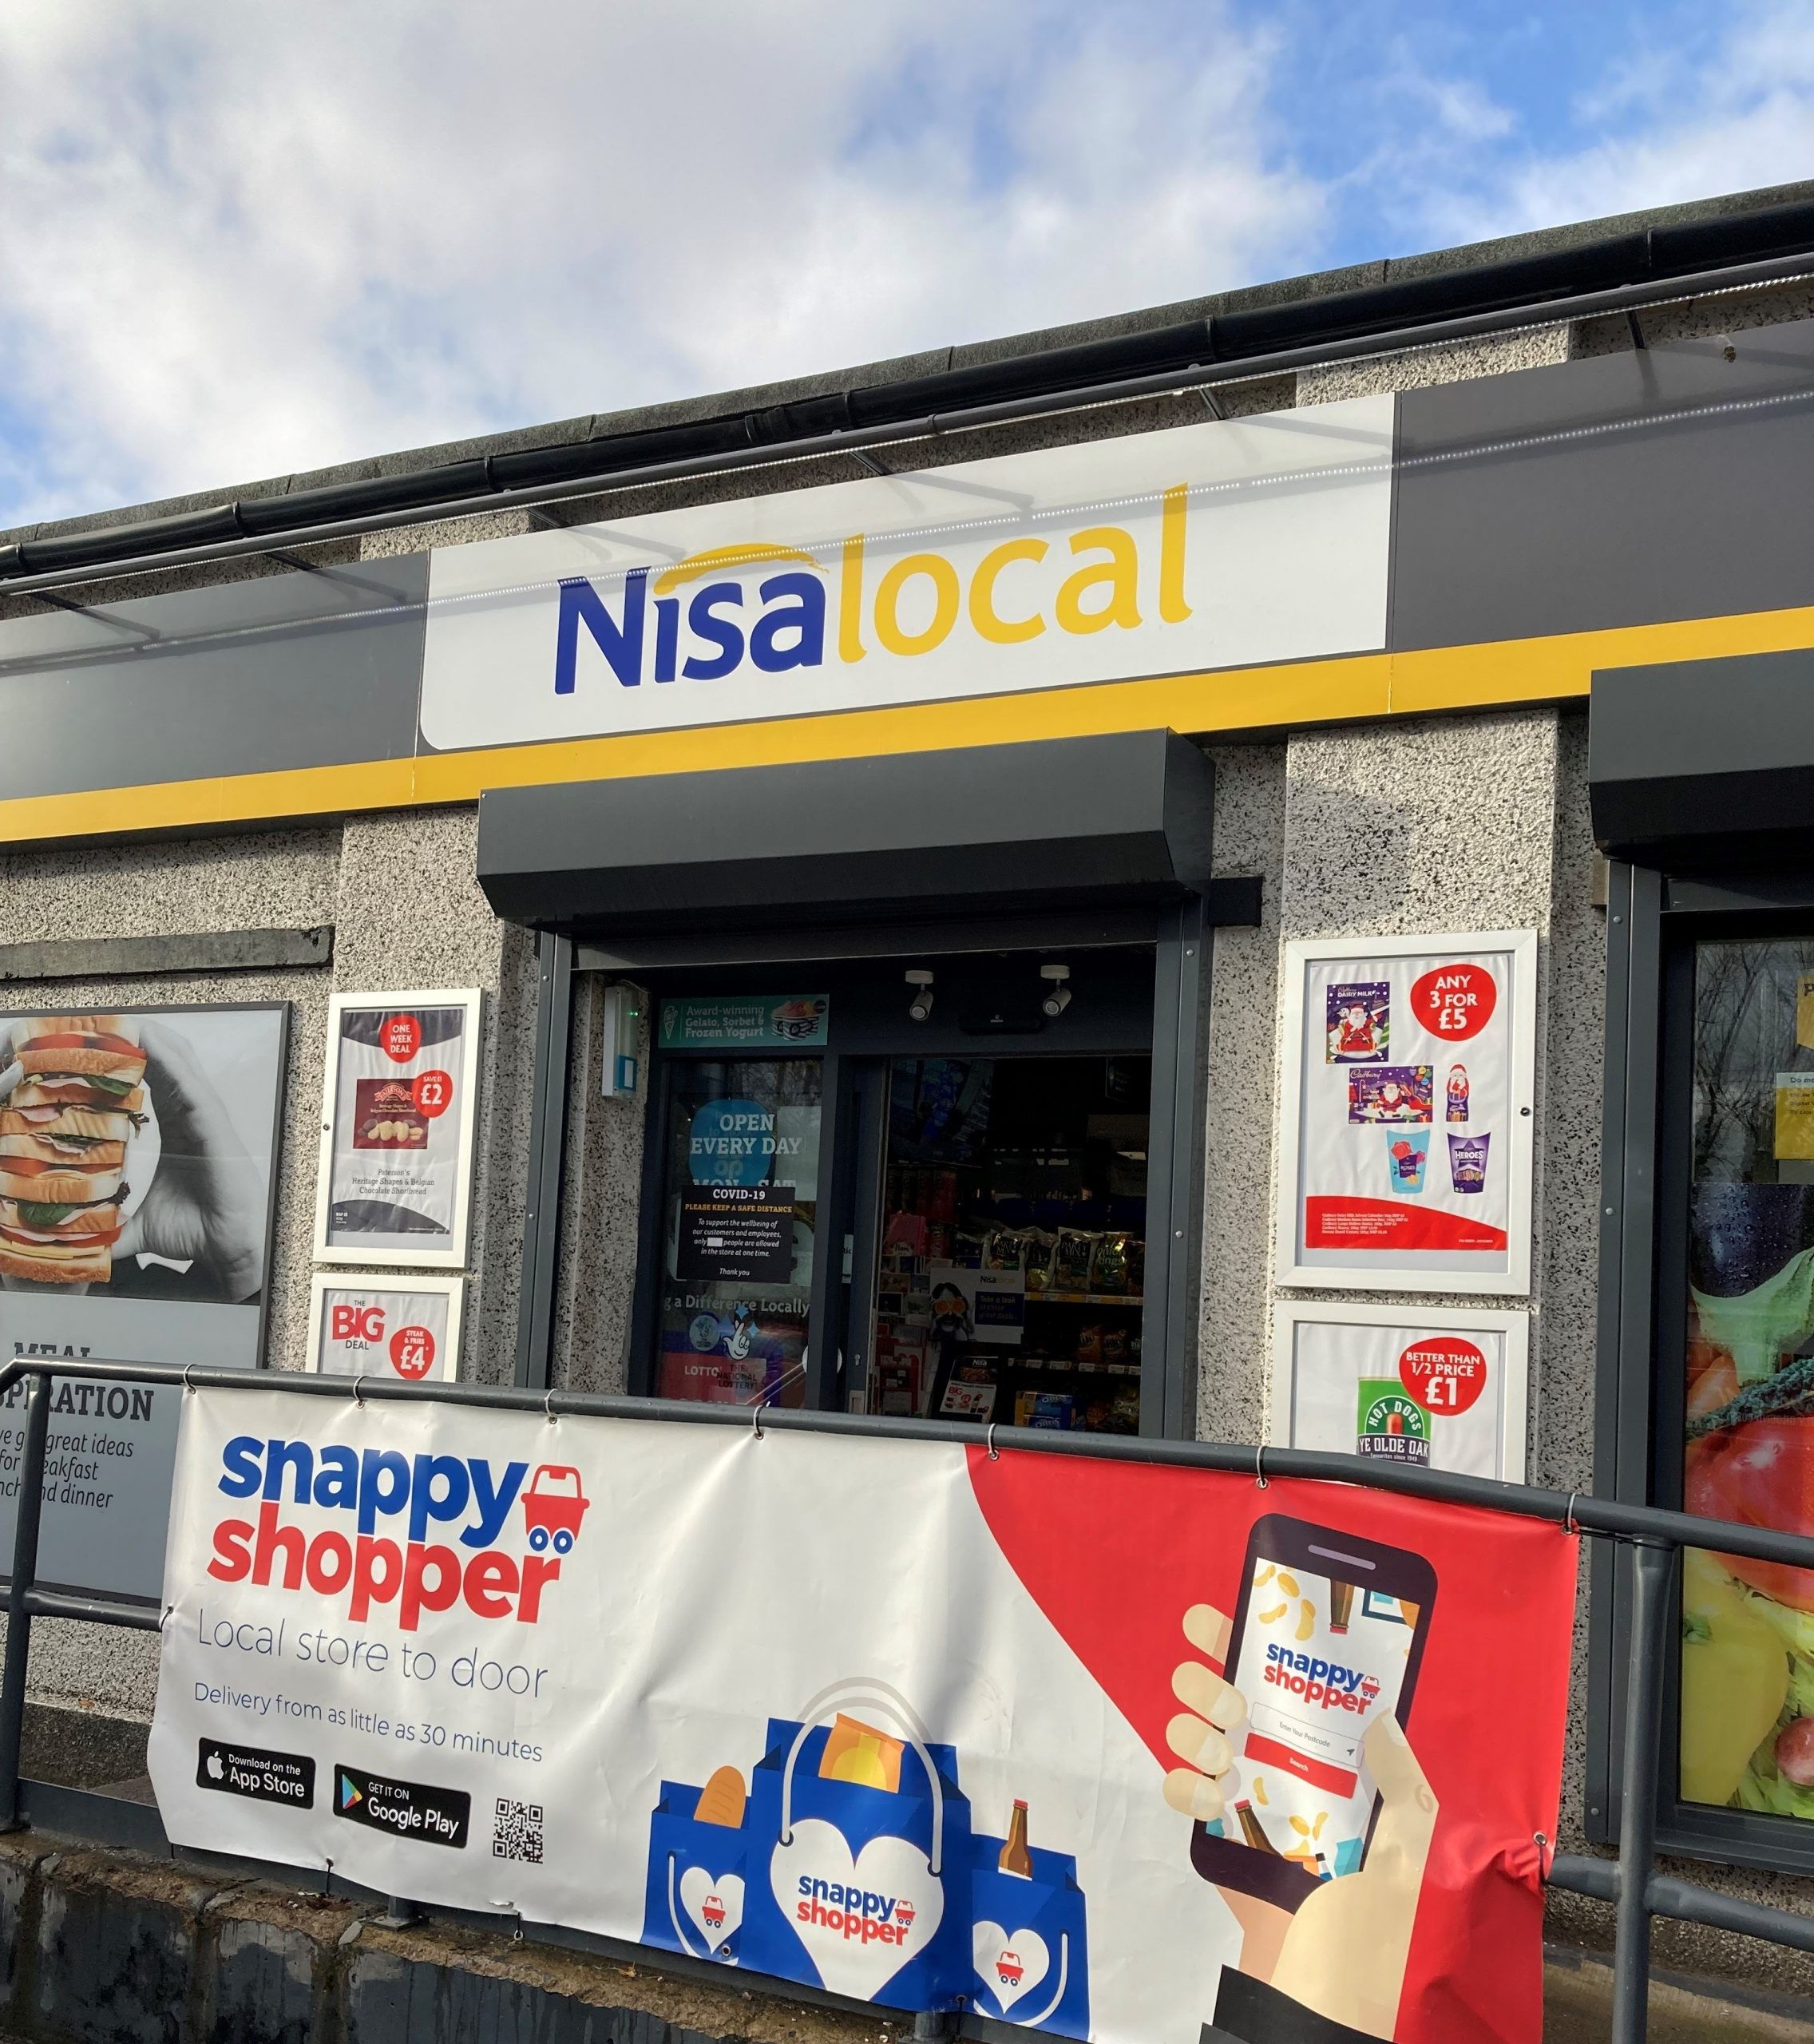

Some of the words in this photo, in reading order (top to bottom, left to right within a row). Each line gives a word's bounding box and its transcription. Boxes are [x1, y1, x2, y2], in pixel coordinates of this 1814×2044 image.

[1435, 974, 1472, 990] ANY
[1429, 991, 1441, 1008] 3
[1445, 991, 1479, 1008] FOR
[686, 1005, 765, 1016] Award-winning
[1438, 1007, 1467, 1030] £5
[392, 1024, 411, 1034] ONE
[685, 1017, 720, 1028] Gelato,
[723, 1016, 755, 1026] Sorbet
[390, 1034, 412, 1044] WEEK
[685, 1027, 723, 1038] Frozen
[726, 1027, 764, 1039] Yogurt
[390, 1044, 411, 1053] DEAL
[1349, 1068, 1381, 1079] Cadbury
[421, 1083, 443, 1105] £2
[719, 1114, 775, 1131] OPEN
[690, 1137, 758, 1155] EVERY
[762, 1137, 802, 1155] DAY
[1455, 1151, 1483, 1161] HEROES
[379, 1178, 403, 1186] Shapes
[410, 1178, 435, 1186] Belgian
[713, 1189, 766, 1200] COVID-19
[706, 1218, 729, 1227] support
[723, 1239, 744, 1248] people
[980, 1275, 996, 1284] Nisa
[674, 1299, 682, 1308] a
[685, 1294, 757, 1310] Difference
[760, 1298, 810, 1317] Locally
[332, 1305, 386, 1343] BIG
[345, 1339, 370, 1350] DEAL
[1405, 1352, 1445, 1363] BETTER
[1448, 1353, 1481, 1365] THAN
[684, 1365, 719, 1377] LOTTO
[716, 1372, 757, 1382] NATIONAL
[1411, 1362, 1432, 1377] 1/2
[1435, 1363, 1475, 1377] PRICE
[1424, 1376, 1457, 1406] £1
[1368, 1402, 1388, 1427] HOT
[1394, 1400, 1421, 1431] DOGS
[46, 1434, 88, 1454] great
[91, 1433, 134, 1457] ideas
[1359, 1437, 1371, 1452] YE
[1373, 1437, 1405, 1453] OLDE
[1408, 1440, 1429, 1458] OAK
[0, 1449, 21, 1471] for
[43, 1456, 99, 1482] eakfast
[42, 1481, 57, 1502] nd
[61, 1483, 113, 1507] dinner
[217, 1435, 530, 1549] snappy
[206, 1500, 561, 1632] shopper
[198, 1608, 285, 1657] Local
[296, 1628, 389, 1673] store
[401, 1644, 437, 1681] to
[451, 1647, 549, 1698] door
[1265, 1642, 1364, 1693] snappy
[1263, 1663, 1372, 1715] shopper
[194, 1682, 271, 1715] Delivery
[275, 1695, 322, 1721] from
[328, 1707, 347, 1725] as
[351, 1709, 389, 1736] little
[394, 1721, 415, 1741] as
[420, 1724, 446, 1747] 30
[454, 1732, 543, 1763] minutes
[1279, 1721, 1292, 1733] Enter
[1292, 1726, 1304, 1737] Your
[1304, 1733, 1331, 1748] Postcode
[228, 1753, 271, 1770] Download
[272, 1762, 283, 1772] on
[286, 1764, 301, 1776] the
[1289, 1757, 1309, 1772] Search
[230, 1767, 260, 1792] App
[263, 1774, 305, 1797] Store
[368, 1781, 383, 1795] GET
[385, 1786, 394, 1796] IT
[394, 1788, 410, 1800] ON
[367, 1796, 422, 1830] Google
[424, 1809, 460, 1839] Play
[798, 1874, 897, 1923] snappy
[796, 1900, 909, 1947] shopper
